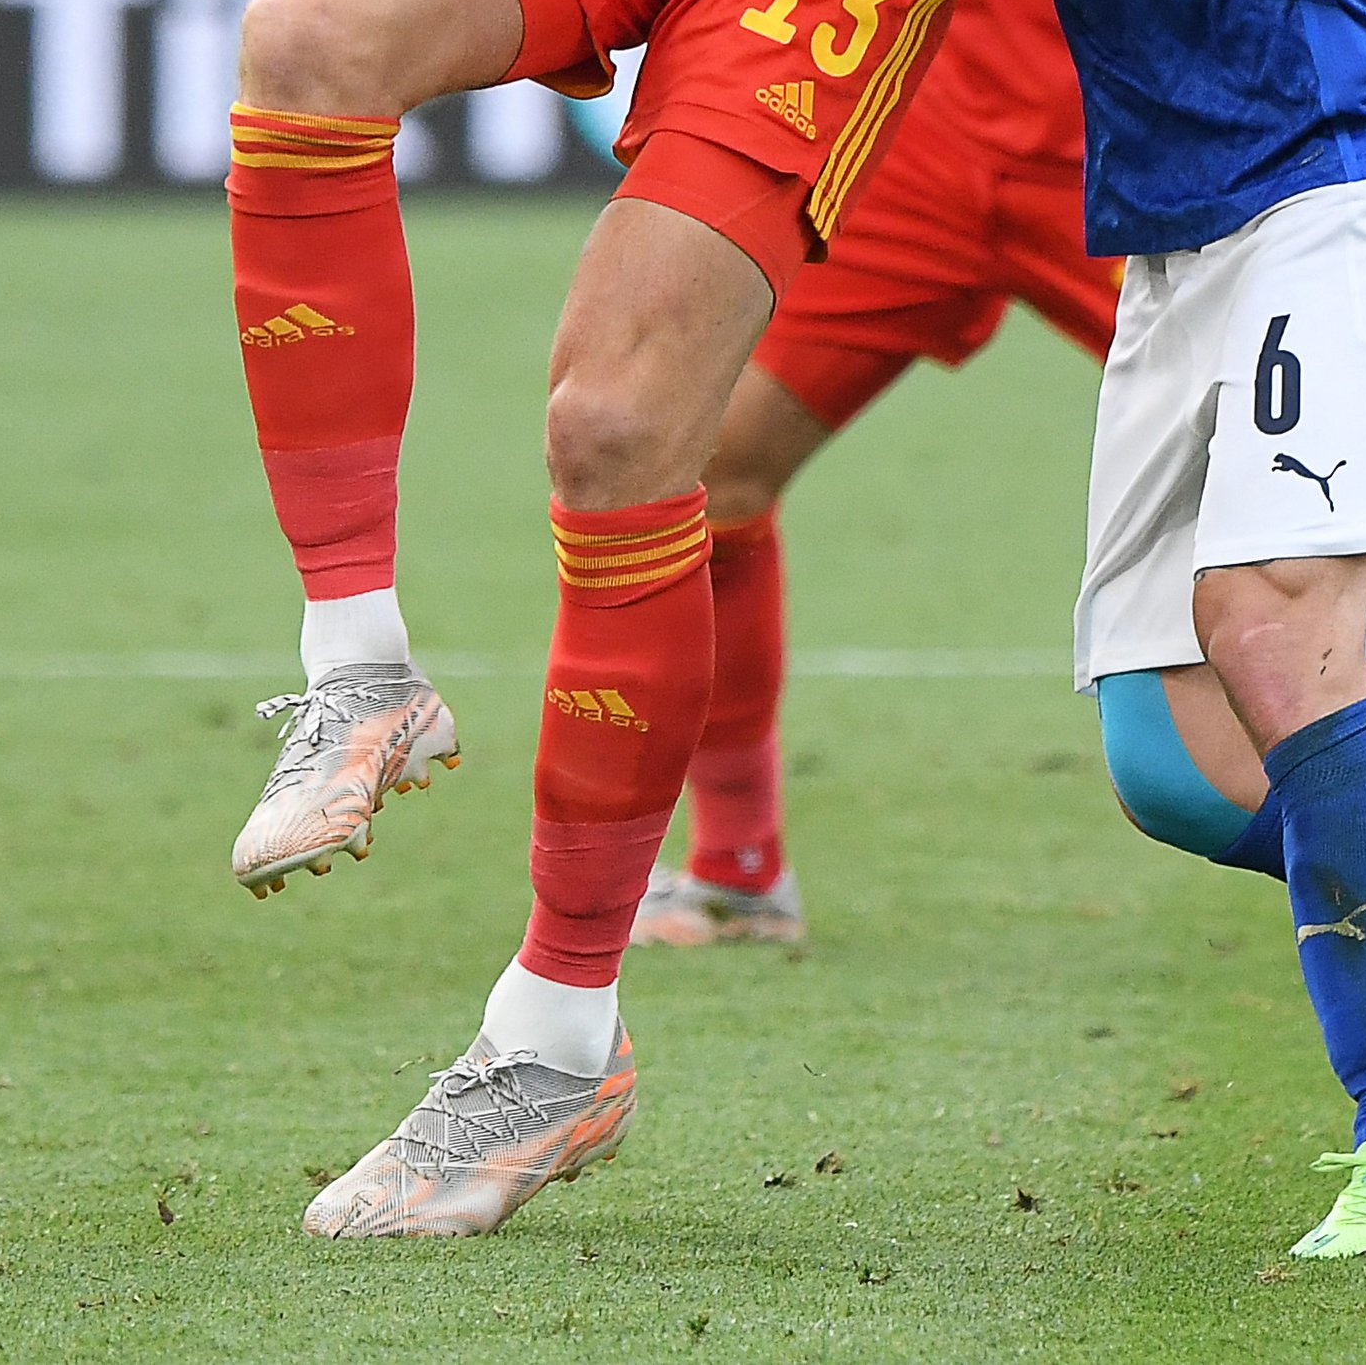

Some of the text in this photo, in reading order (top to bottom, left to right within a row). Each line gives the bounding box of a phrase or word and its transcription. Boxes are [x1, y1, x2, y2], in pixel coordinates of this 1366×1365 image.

[754, 87, 817, 141] adidas
[240, 325, 356, 348] adidas
[1253, 312, 1302, 436] 6
[546, 690, 650, 732] adidas
